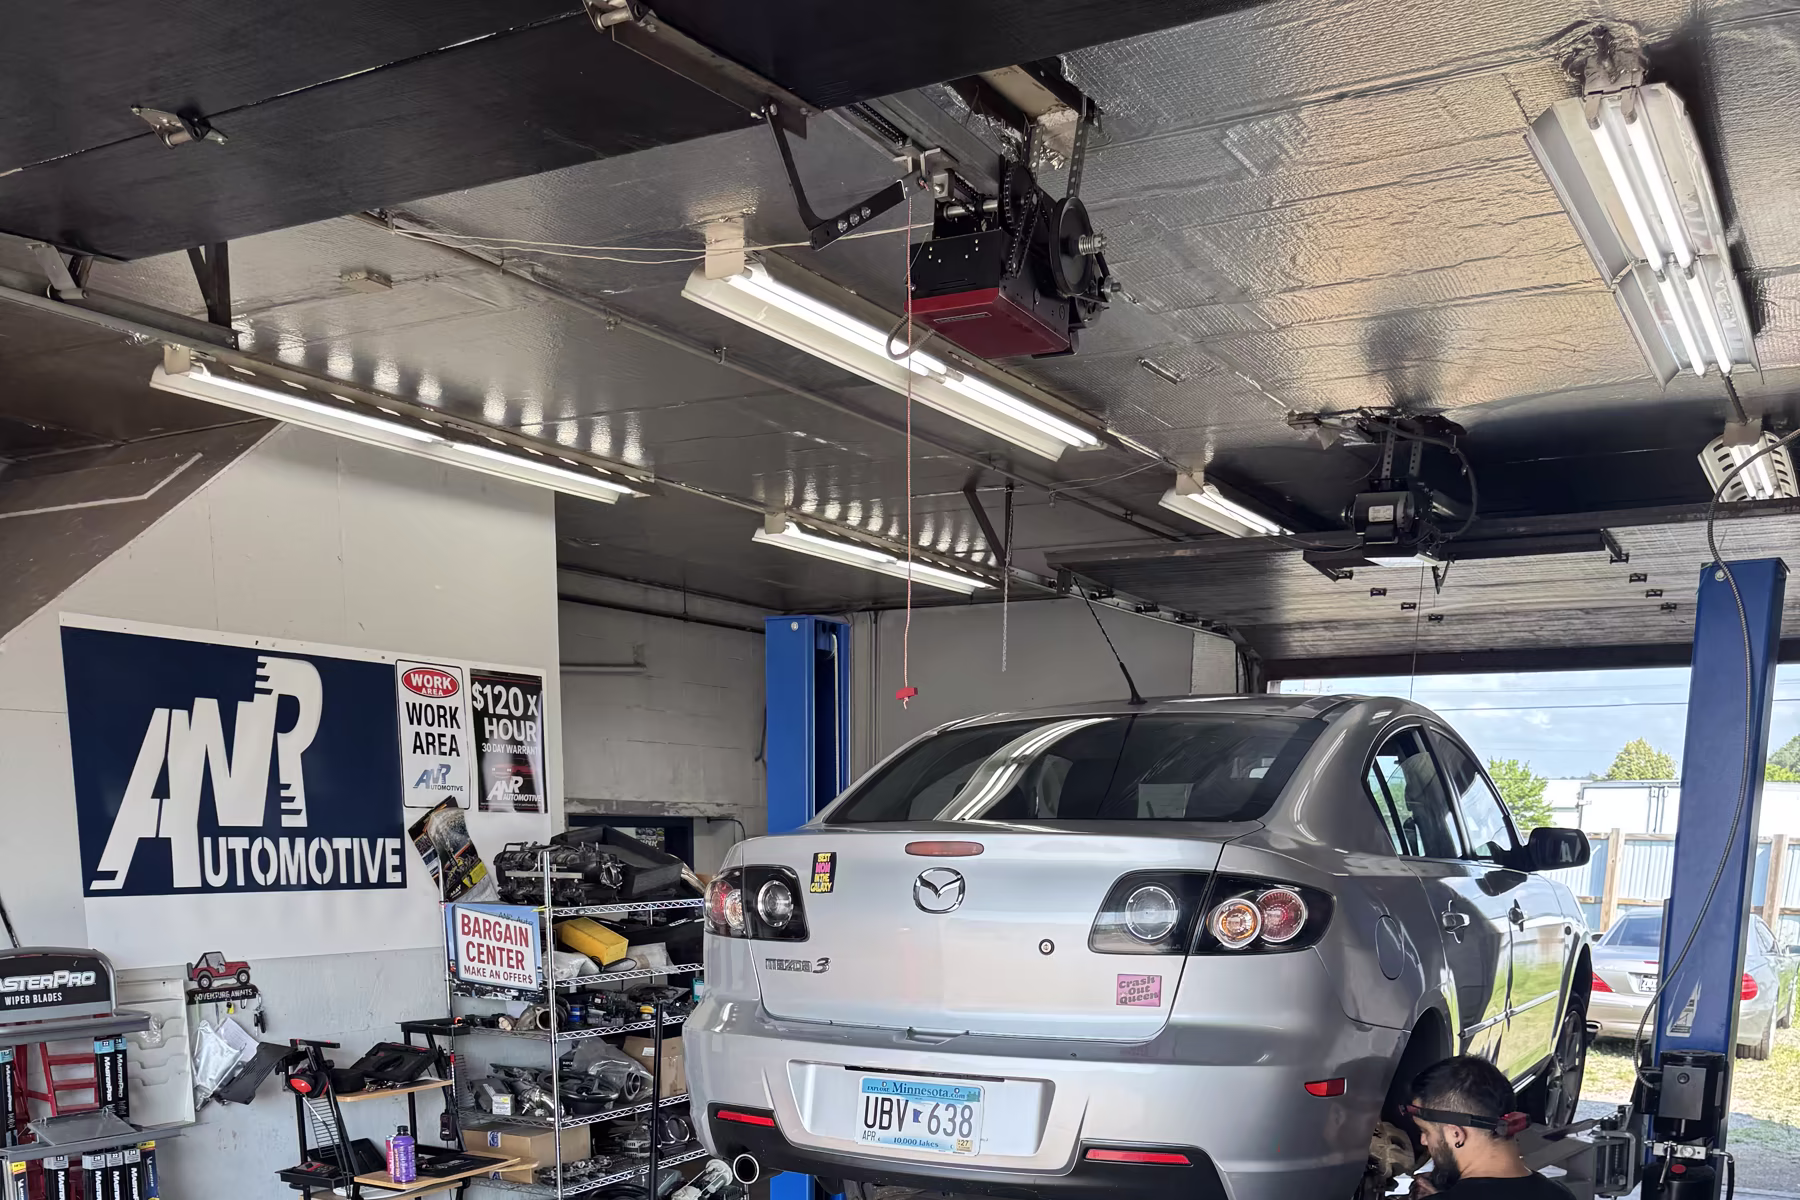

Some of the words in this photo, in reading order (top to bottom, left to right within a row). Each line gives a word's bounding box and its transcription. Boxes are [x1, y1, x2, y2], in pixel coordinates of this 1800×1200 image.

[410, 673, 452, 690] WORK
[421, 688, 444, 697] AREA
[471, 681, 524, 717] $120
[405, 702, 461, 729] WORK
[483, 717, 537, 742] HOUR
[412, 731, 461, 758] AREA
[481, 742, 492, 753] 30
[492, 743, 506, 754] DAY
[505, 744, 539, 756] WARRANT
[89, 655, 323, 890] ANR
[412, 763, 452, 790] ANR
[485, 775, 524, 801] ANR
[461, 913, 529, 948] BARGAIN
[466, 941, 525, 971] CENTER
[463, 964, 487, 978] MAKE
[489, 969, 501, 980] AN
[502, 971, 533, 985] OFFER$
[1118, 975, 1156, 989] Crash
[4, 994, 31, 1006] WIPER
[32, 992, 63, 1004] BLADES
[1119, 992, 1159, 1005] Queen
[1127, 985, 1151, 996] Out
[864, 1095, 909, 1132] UBV
[927, 1102, 973, 1139] 638
[862, 1130, 877, 1141] APR
[893, 1137, 918, 1146] 10,000
